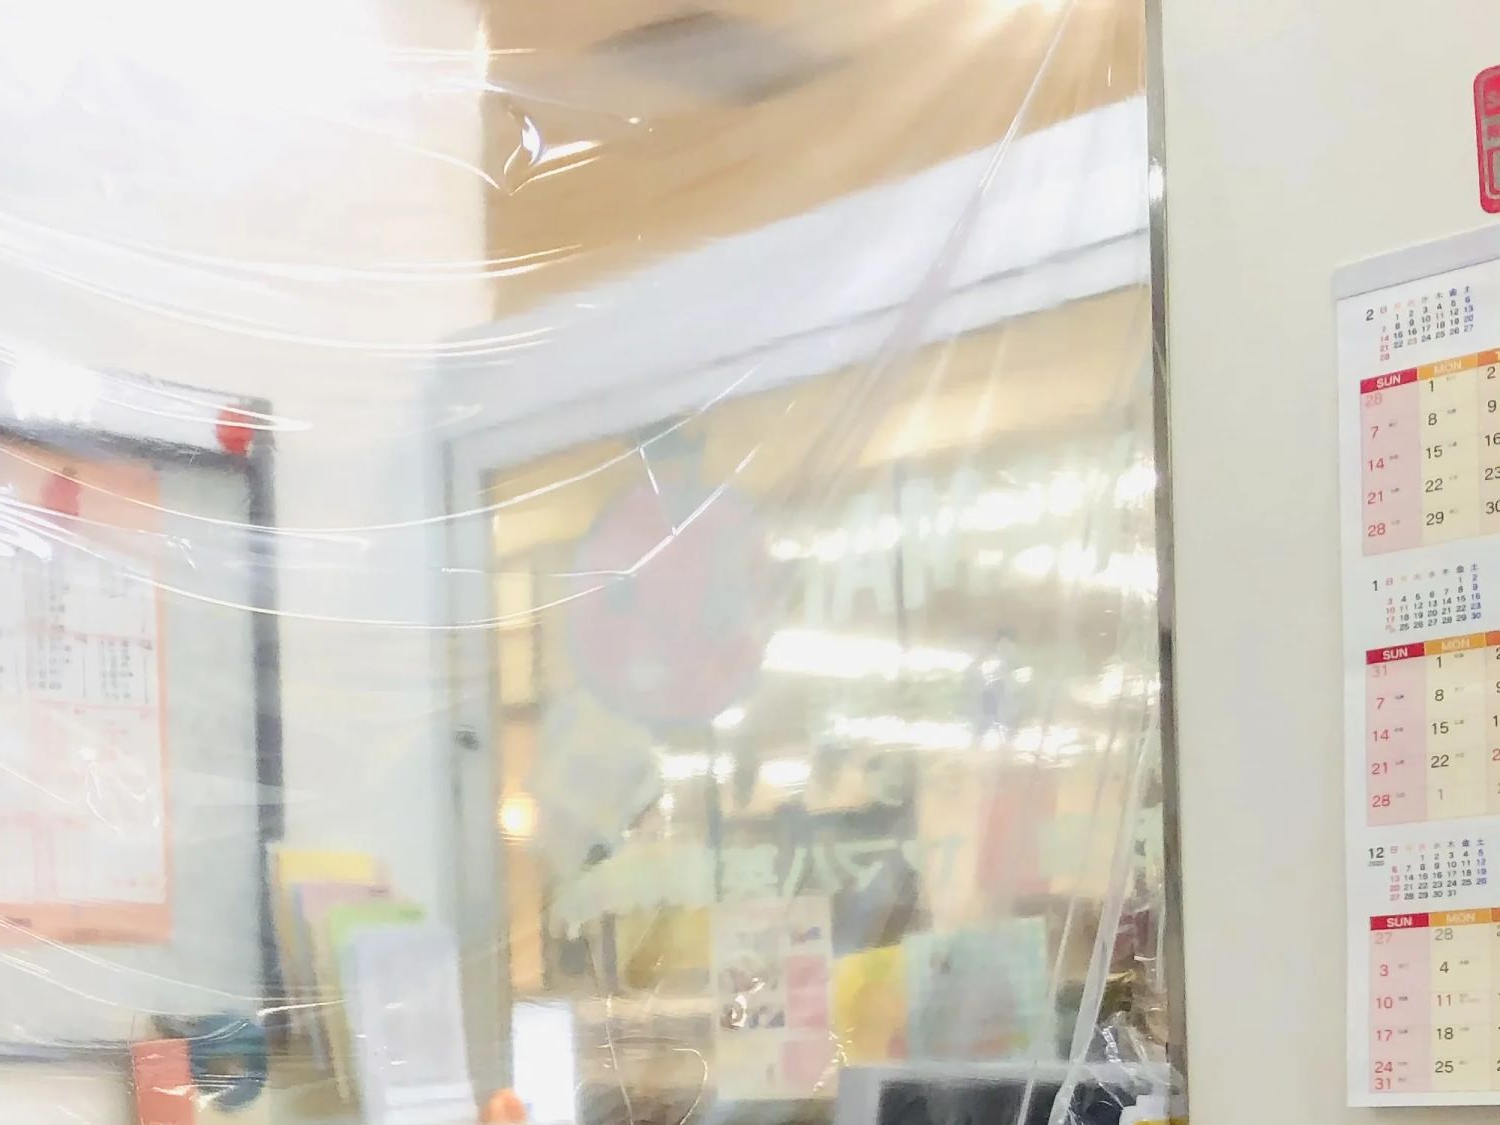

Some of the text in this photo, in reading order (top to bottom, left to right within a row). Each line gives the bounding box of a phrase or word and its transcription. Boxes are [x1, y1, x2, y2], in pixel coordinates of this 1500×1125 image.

[1365, 309, 1374, 321] 2
[1376, 375, 1401, 388] SUN
[1429, 380, 1434, 392] 1
[1487, 366, 1496, 379] 2
[1371, 400, 1497, 439] 7 8 9
[1368, 458, 1385, 471] 14
[1426, 446, 1443, 459] 15
[1368, 491, 1383, 504] 21
[1425, 478, 1443, 492] 22
[1368, 523, 1386, 537] 28
[1426, 512, 1444, 526] 29
[1372, 580, 1378, 591] 1
[1383, 648, 1408, 660] SUN
[1436, 656, 1442, 668] 1
[1376, 689, 1444, 709] 7 8
[1373, 722, 1449, 742] 14 15
[1372, 755, 1450, 775] 21 22
[1372, 795, 1390, 808] 28
[1369, 847, 1384, 859] 12
[1386, 916, 1412, 928] SUN
[1434, 928, 1453, 940] 28
[1380, 961, 1449, 976] 3 4
[1376, 994, 1451, 1009] 10 11
[1376, 1027, 1453, 1041] 17 18
[1375, 1061, 1454, 1073] 24 25
[1375, 1078, 1391, 1090] 31
